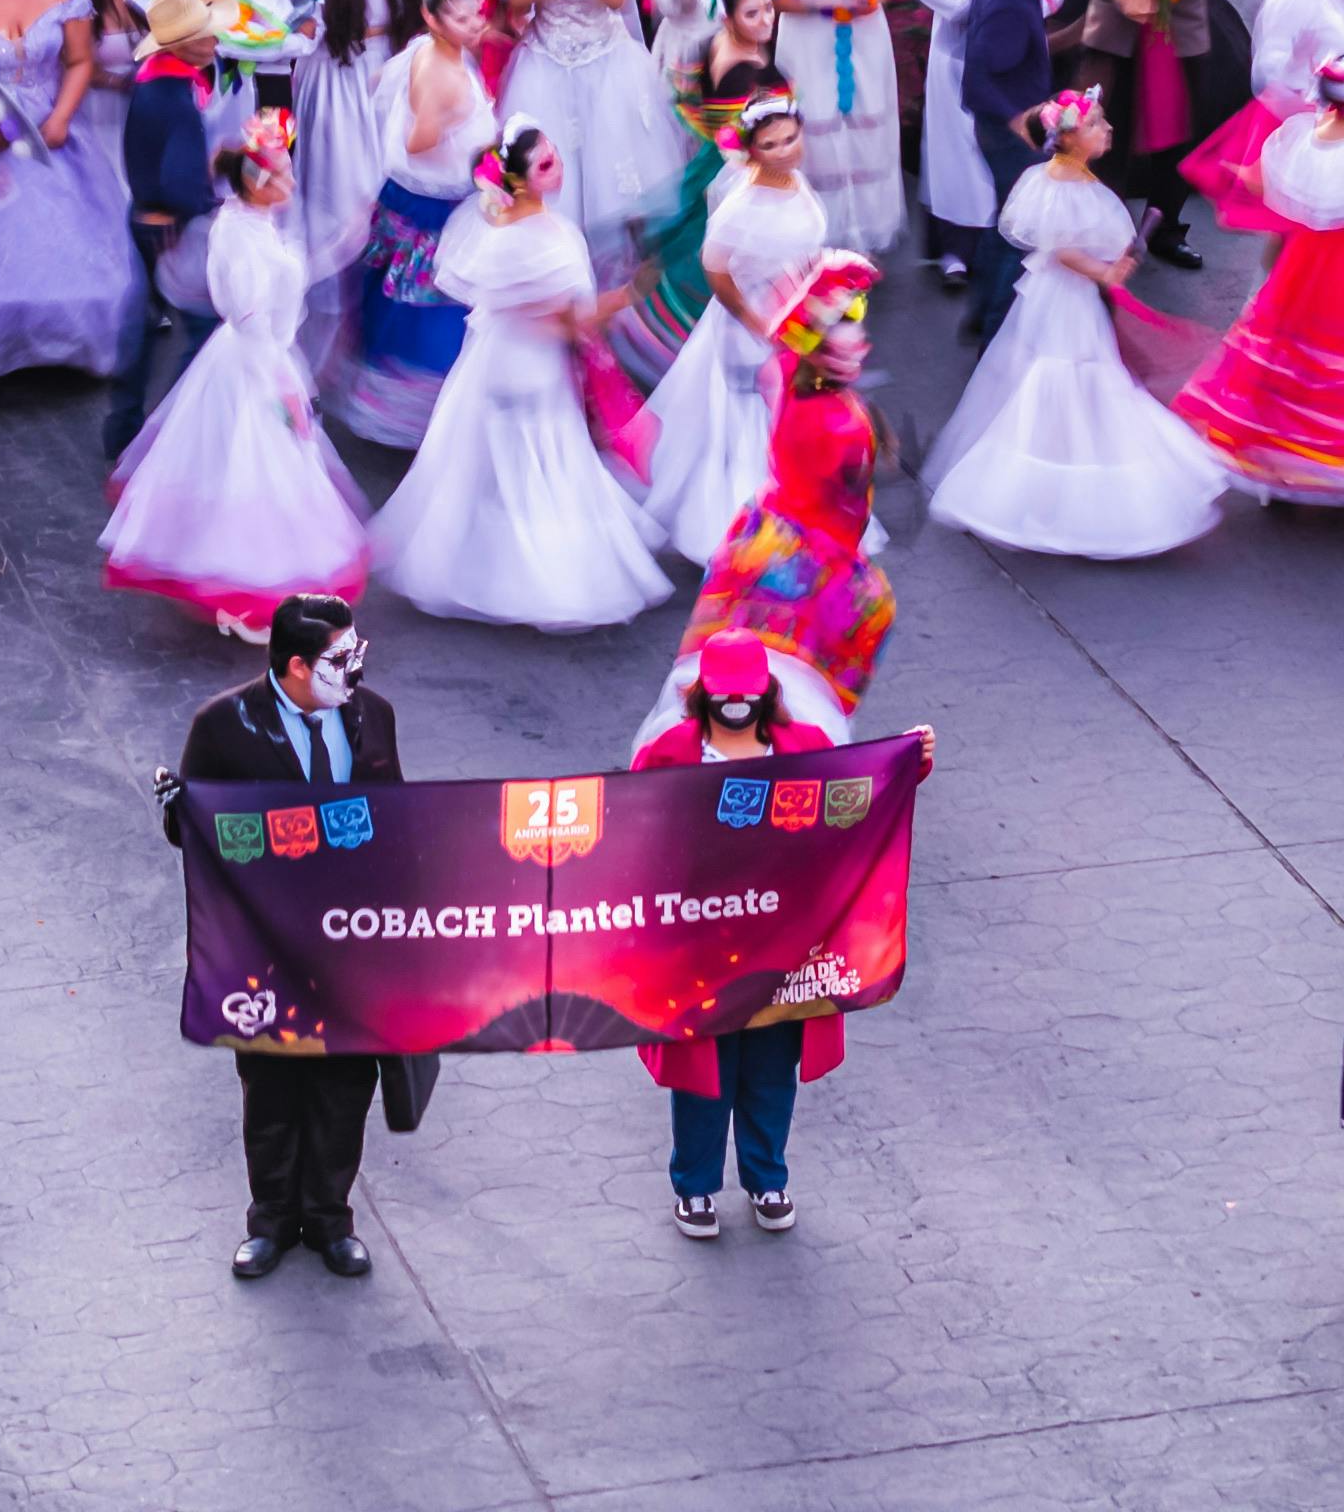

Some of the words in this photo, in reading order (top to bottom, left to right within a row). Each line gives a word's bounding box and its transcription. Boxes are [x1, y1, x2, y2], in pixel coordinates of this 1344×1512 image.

[528, 788, 579, 828] 25
[322, 905, 497, 941] COBACH
[507, 895, 645, 936] Plantel
[655, 887, 780, 925] Tecate
[817, 960, 840, 979] DE
[779, 976, 851, 1005] MUERTOS
